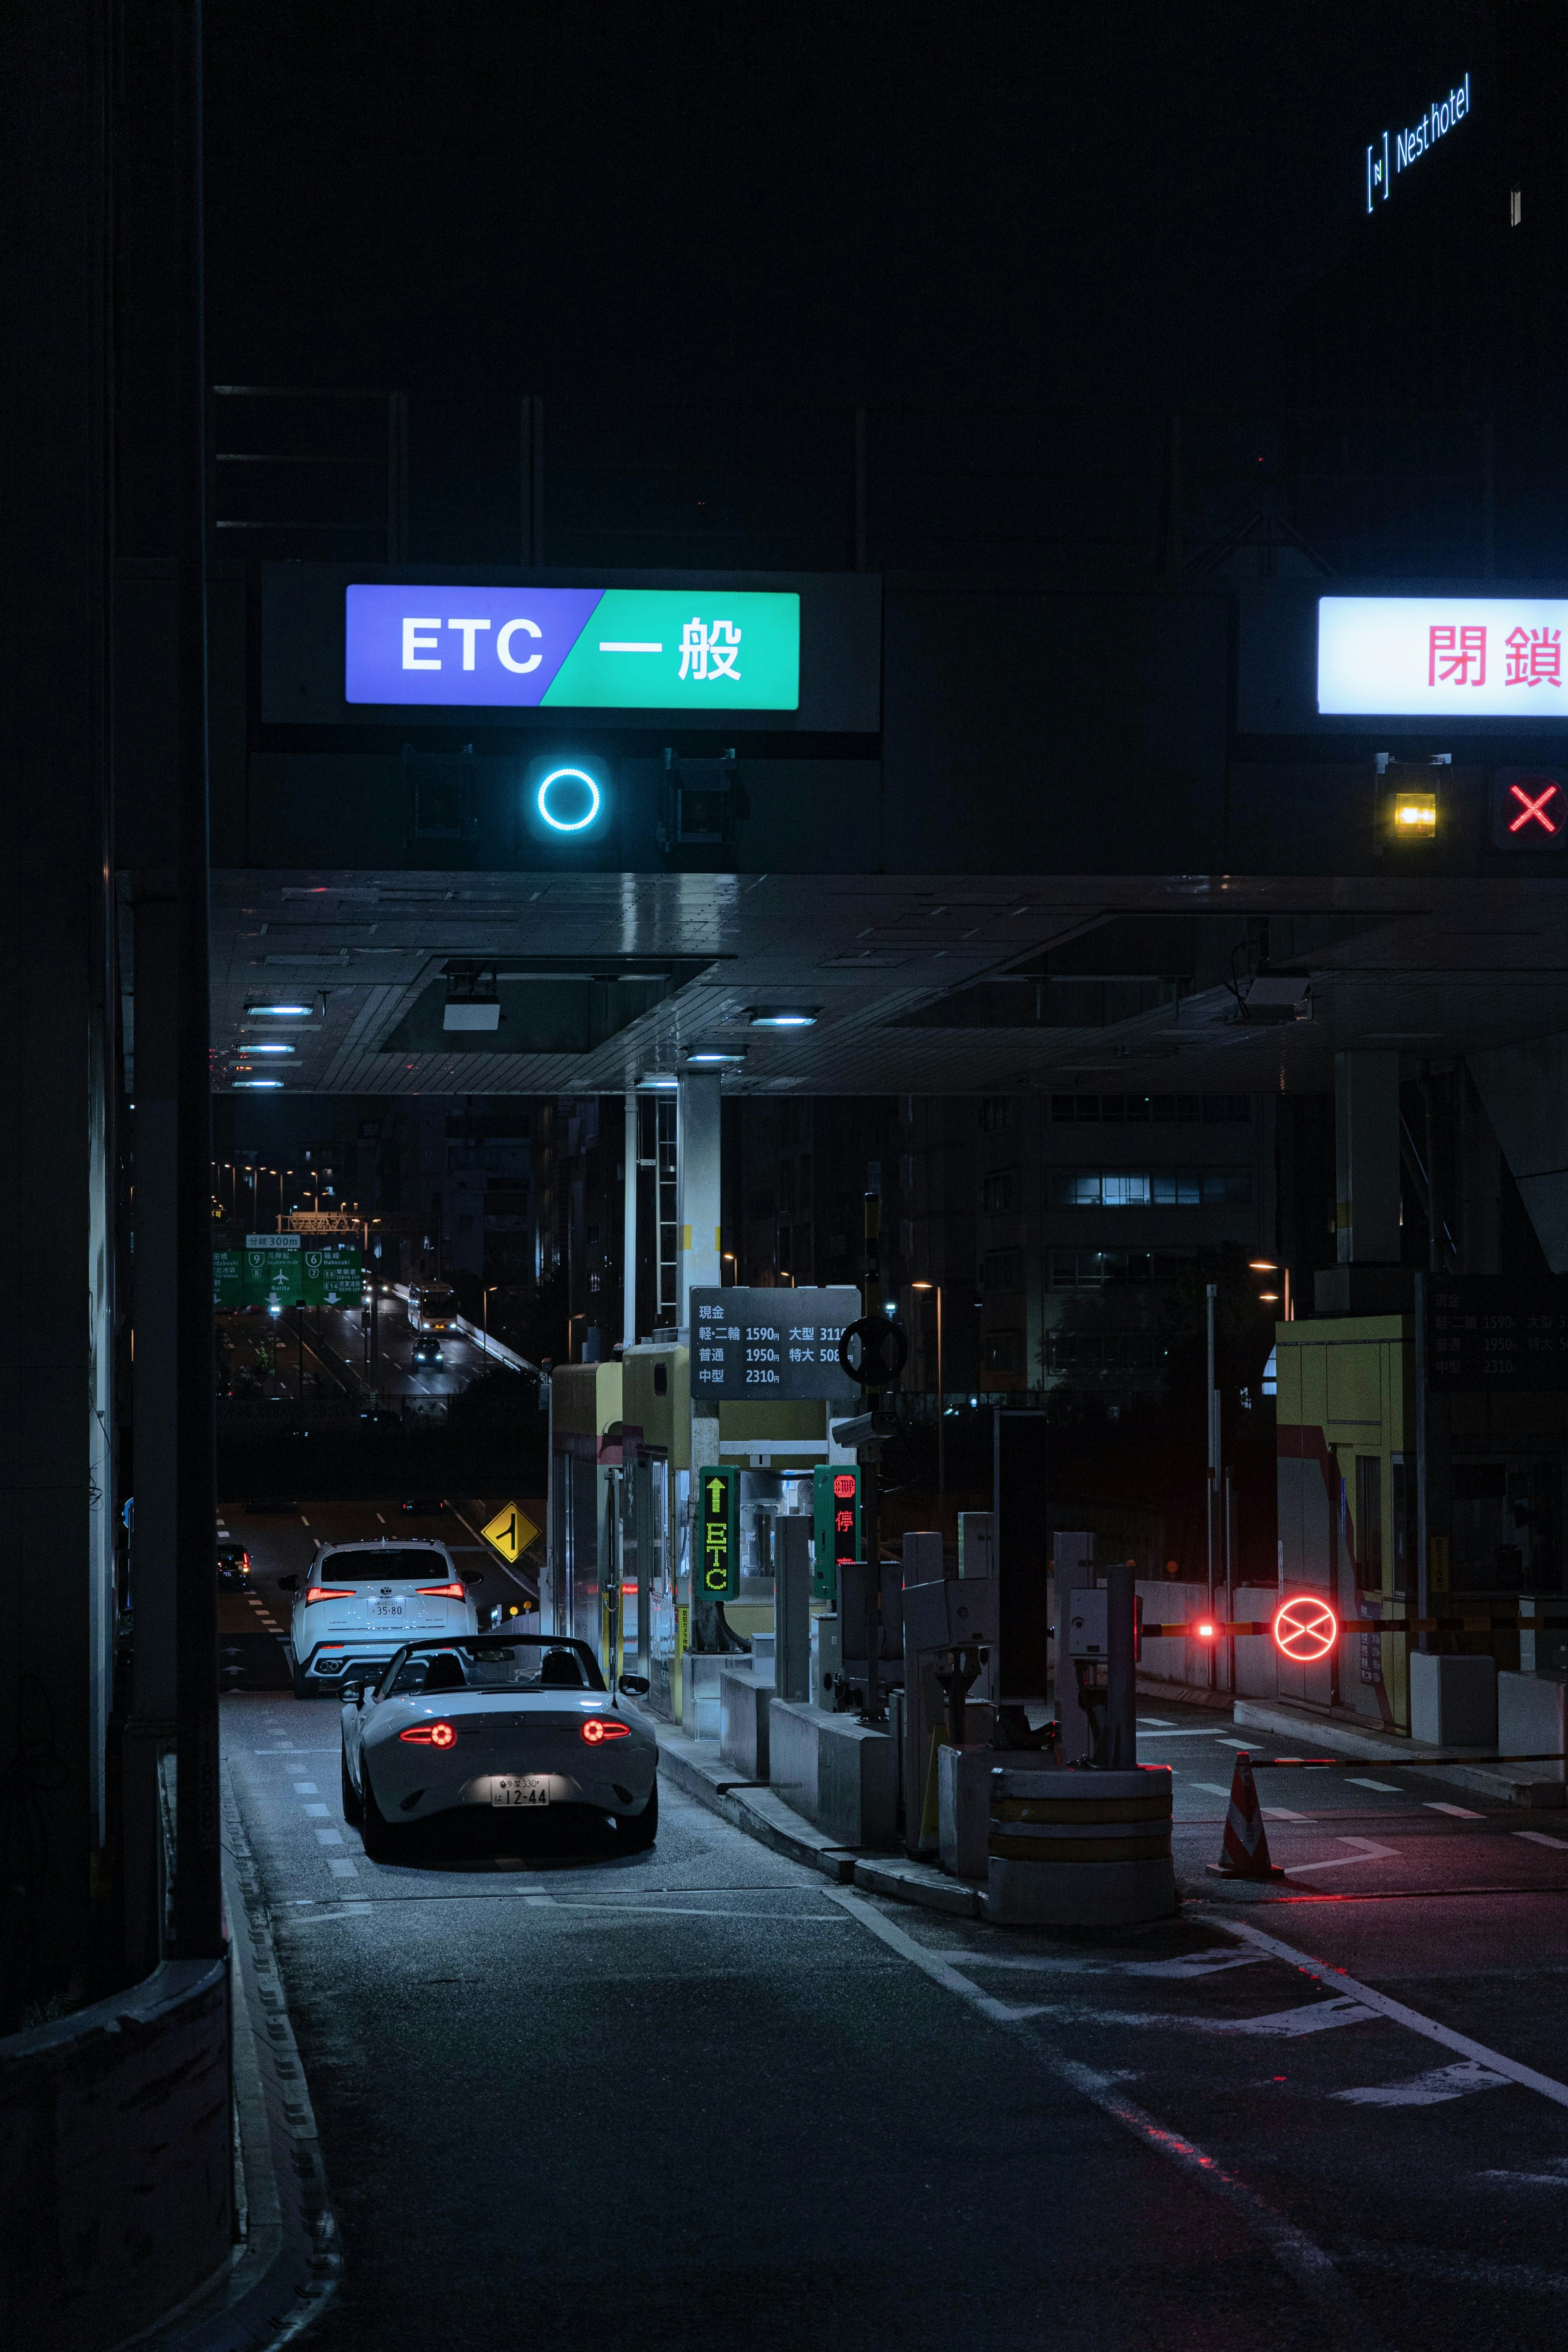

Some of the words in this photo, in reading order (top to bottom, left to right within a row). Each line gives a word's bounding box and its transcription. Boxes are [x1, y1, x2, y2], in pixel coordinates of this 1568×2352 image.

[1397, 114, 1429, 173] Nest
[1431, 72, 1469, 143] hotel
[402, 617, 543, 673] ETC
[599, 617, 742, 681] 一般
[1428, 625, 1562, 687] 閉鎖
[250, 1237, 267, 1245] 分岐
[270, 1237, 297, 1245] 300m
[254, 1254, 260, 1264] 9
[311, 1254, 317, 1264] 6
[699, 1305, 724, 1320] 現金
[1527, 1315, 1552, 1329] 大型
[699, 1326, 740, 1341] 軽・二輪
[746, 1327, 780, 1341] 1590円
[789, 1327, 814, 1341] 大型
[699, 1348, 724, 1362] 普通
[746, 1348, 780, 1362] 1950円
[789, 1348, 814, 1362] 特大
[820, 1348, 853, 1362] 508円
[1436, 1359, 1461, 1374] 中型
[699, 1369, 724, 1383] 中型
[746, 1369, 780, 1383] 2310円
[706, 1523, 727, 1590] ETC
[377, 1606, 402, 1615] 35-80
[507, 1789, 546, 1805] 12-44
